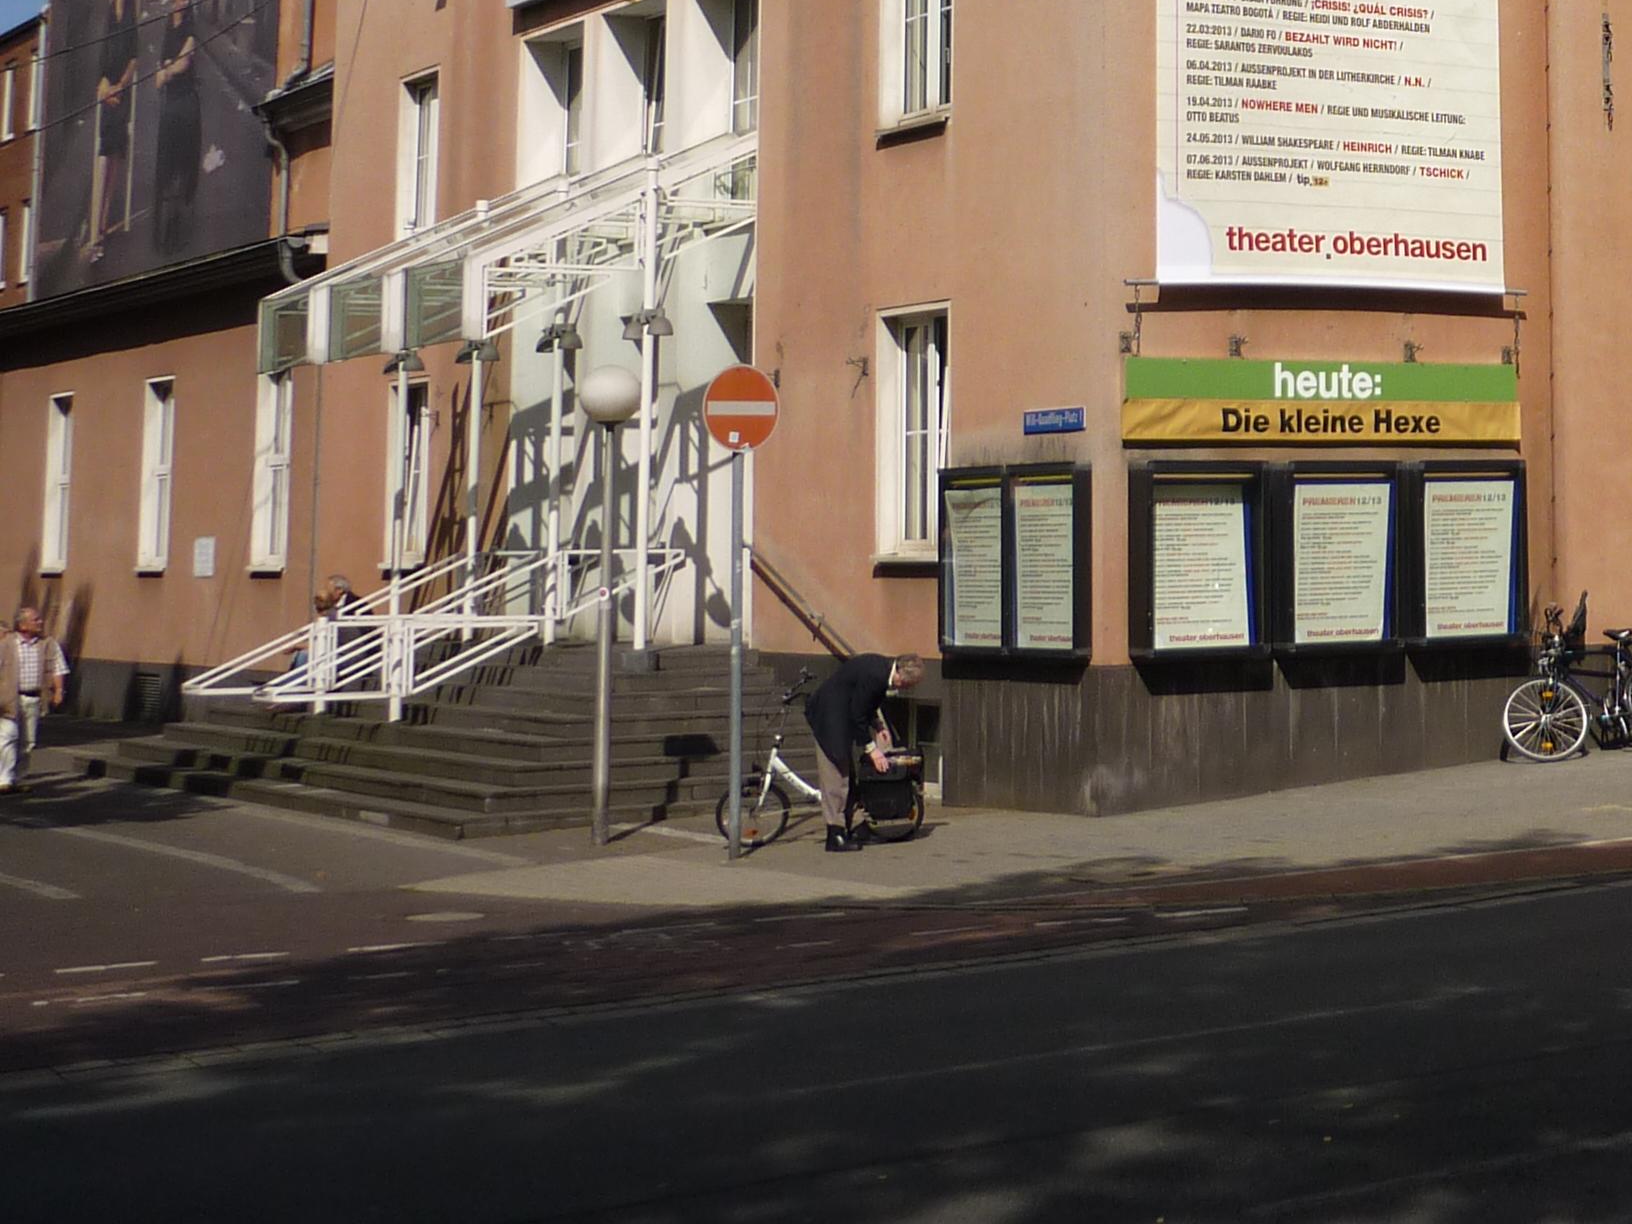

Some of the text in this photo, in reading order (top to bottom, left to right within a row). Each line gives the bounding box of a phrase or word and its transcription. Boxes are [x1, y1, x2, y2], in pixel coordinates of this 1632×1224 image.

[1274, 363, 1382, 398] heute:
[1221, 408, 1441, 433] Die kleine Hexe
